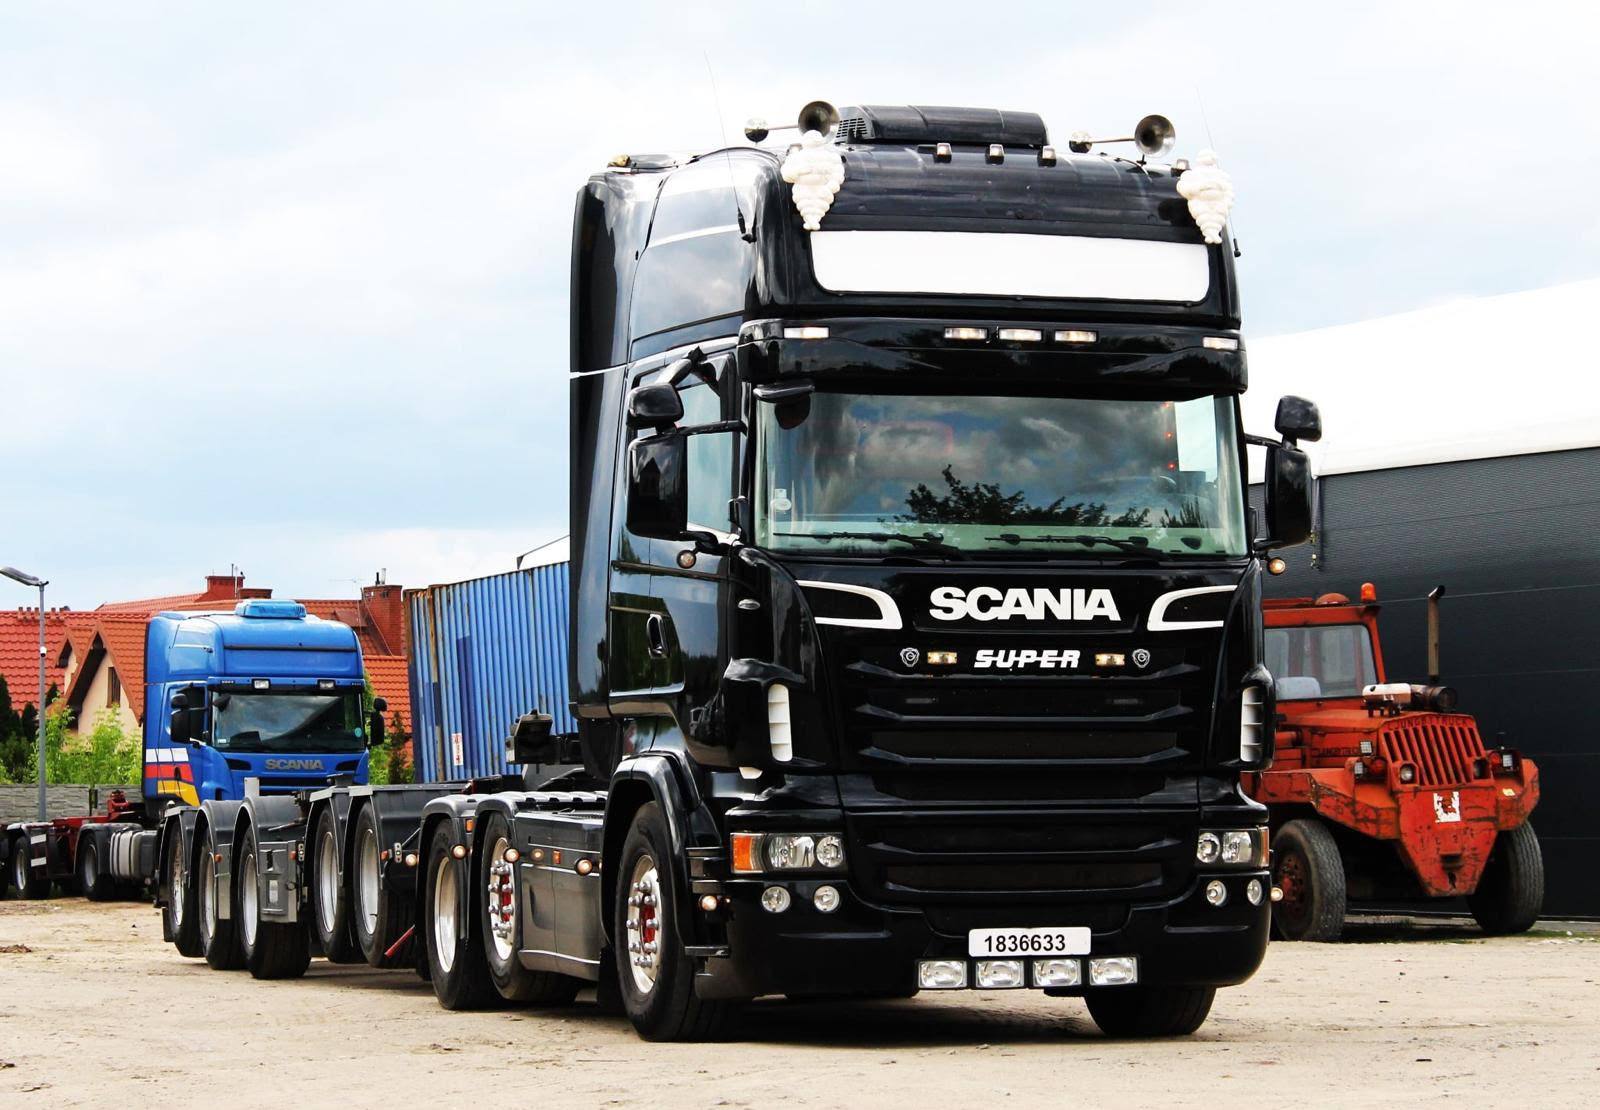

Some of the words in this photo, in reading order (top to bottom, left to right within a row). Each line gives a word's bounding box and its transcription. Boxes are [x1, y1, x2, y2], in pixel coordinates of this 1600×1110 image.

[929, 587, 1121, 620] SCANIA
[974, 650, 1081, 668] SUPER
[265, 759, 324, 770] SCANIA
[985, 934, 1065, 952] 1836633
